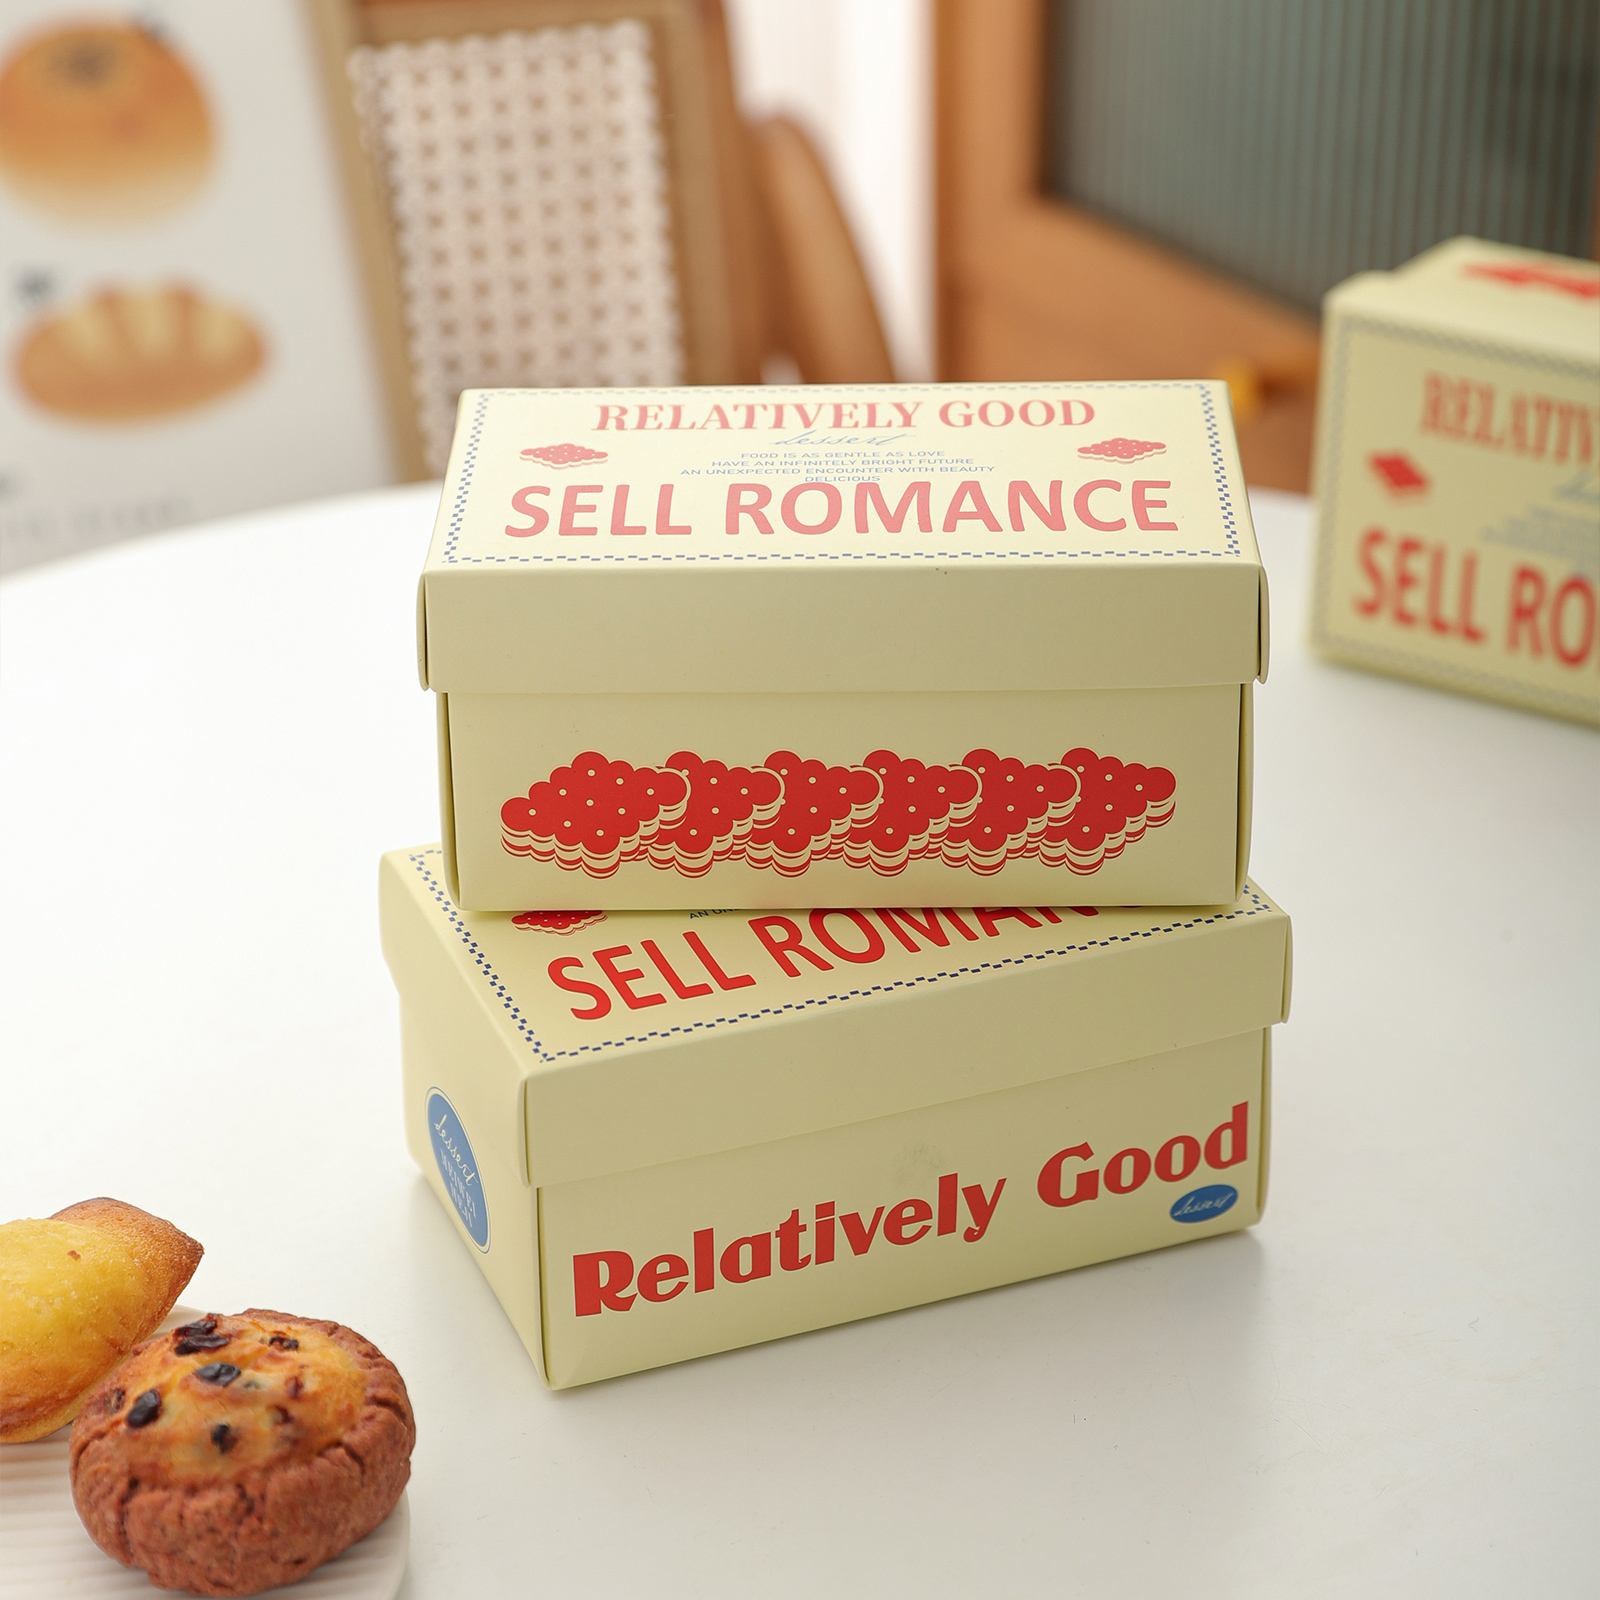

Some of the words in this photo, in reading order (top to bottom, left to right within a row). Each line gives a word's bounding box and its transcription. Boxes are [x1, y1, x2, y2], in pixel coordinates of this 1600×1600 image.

[591, 402, 922, 431] RELATIVELY
[938, 399, 1095, 428] GOOD
[770, 429, 916, 446] dessert
[505, 484, 692, 538] SELL
[725, 479, 1178, 535] ROMANCE
[804, 475, 881, 483] DELICIOUS
[1354, 527, 1487, 644] SELL
[689, 910, 709, 919] AN
[547, 929, 757, 1020] SELL
[433, 1114, 478, 1186] dessert
[573, 1172, 1007, 1317] Relatively
[1037, 1101, 1248, 1208] Good
